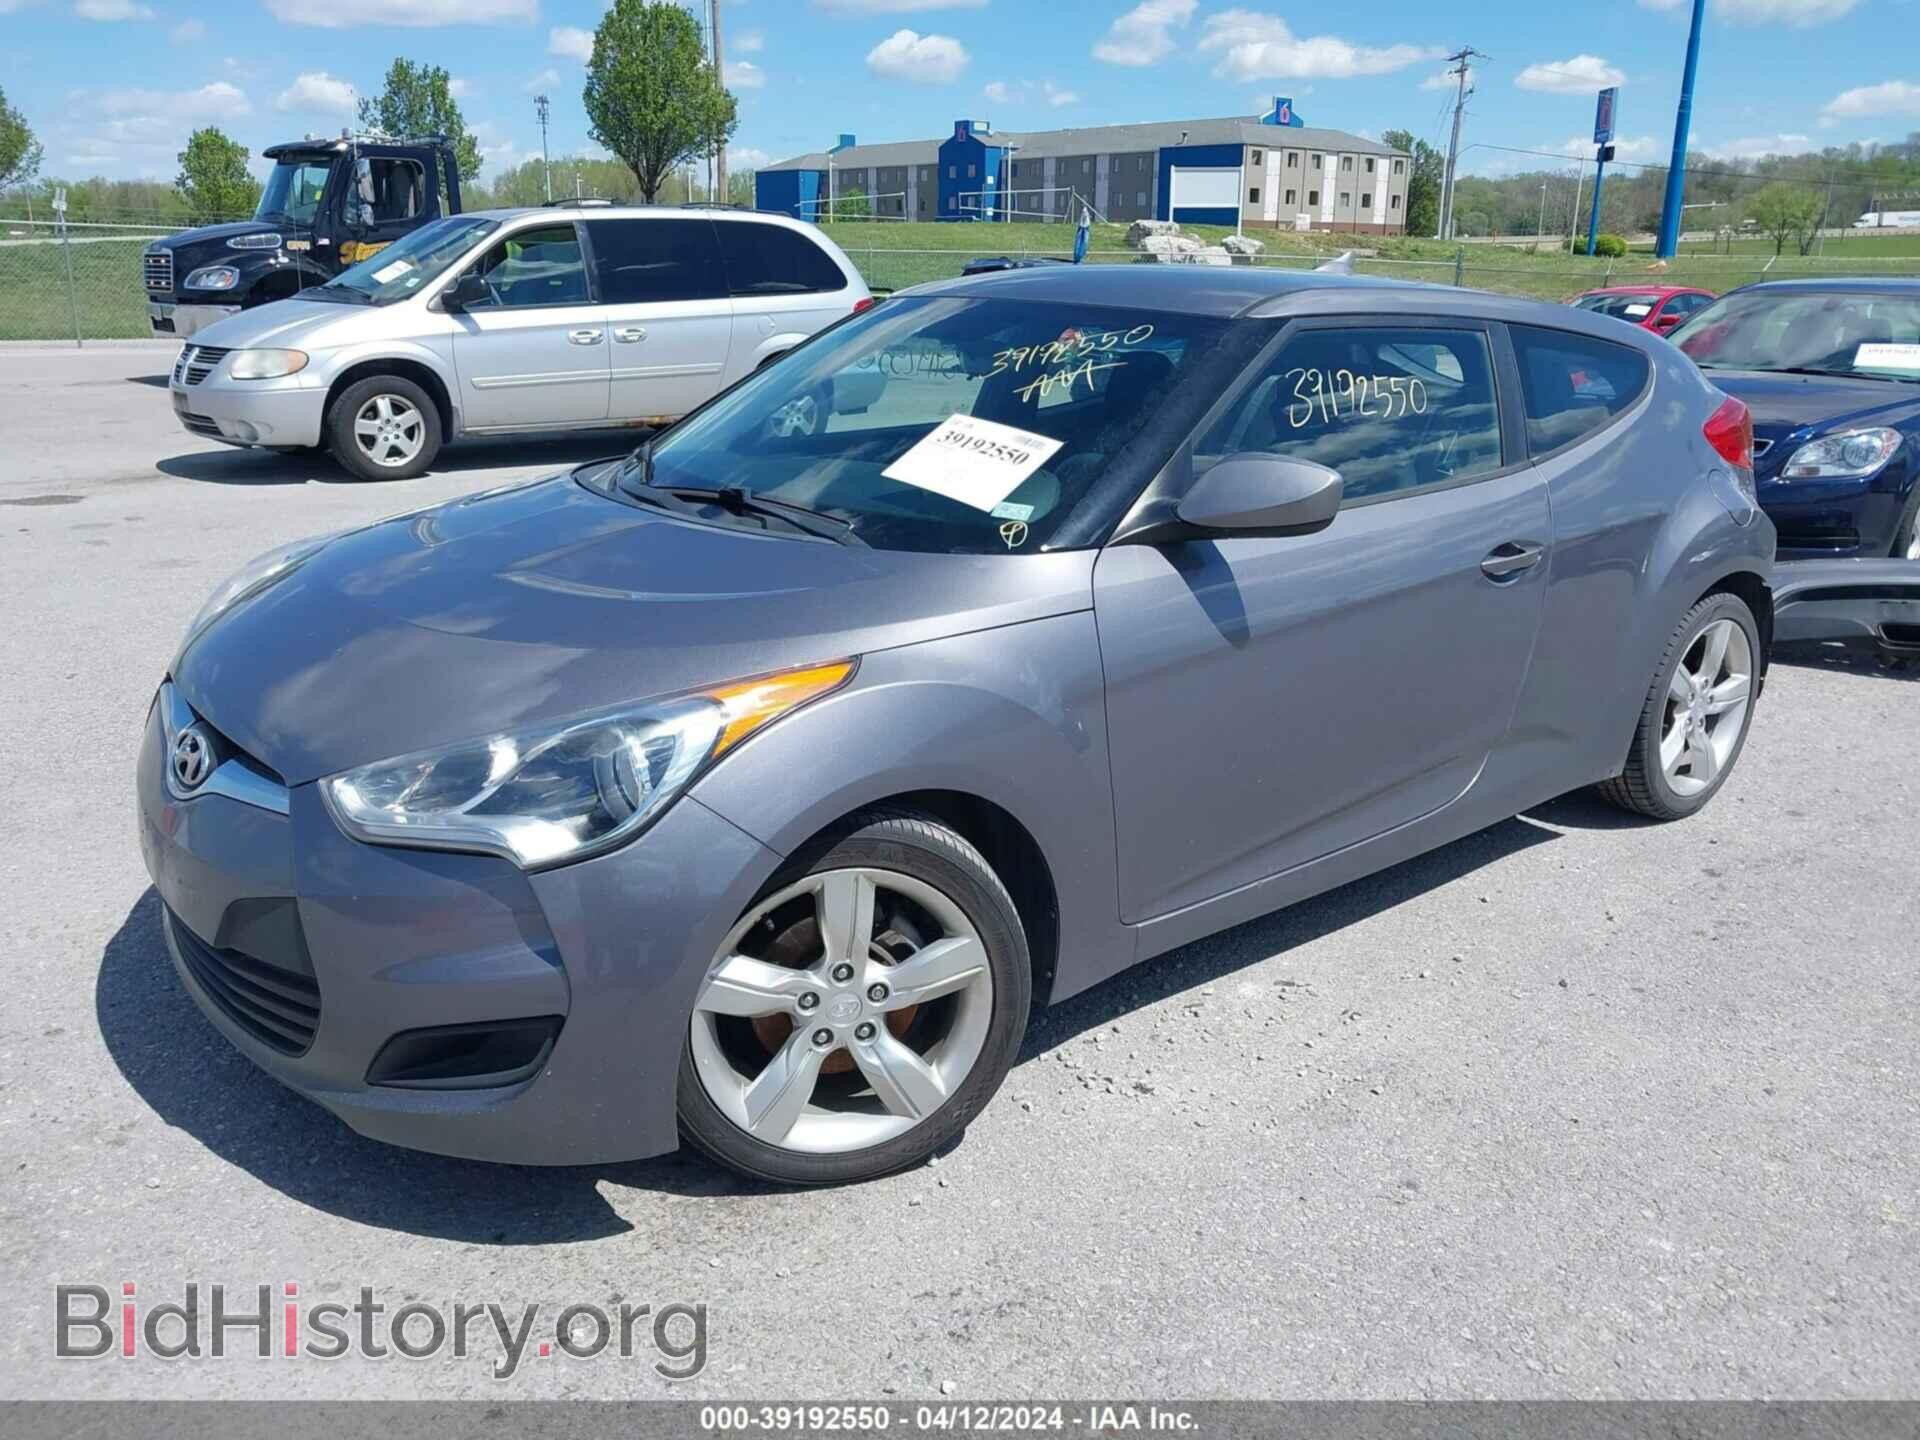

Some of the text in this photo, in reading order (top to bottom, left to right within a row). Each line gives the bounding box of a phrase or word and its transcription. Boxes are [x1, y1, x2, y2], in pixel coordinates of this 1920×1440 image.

[979, 324, 1155, 378] 39192550
[1285, 368, 1428, 428] 39192550
[936, 430, 1031, 466] 39192550
